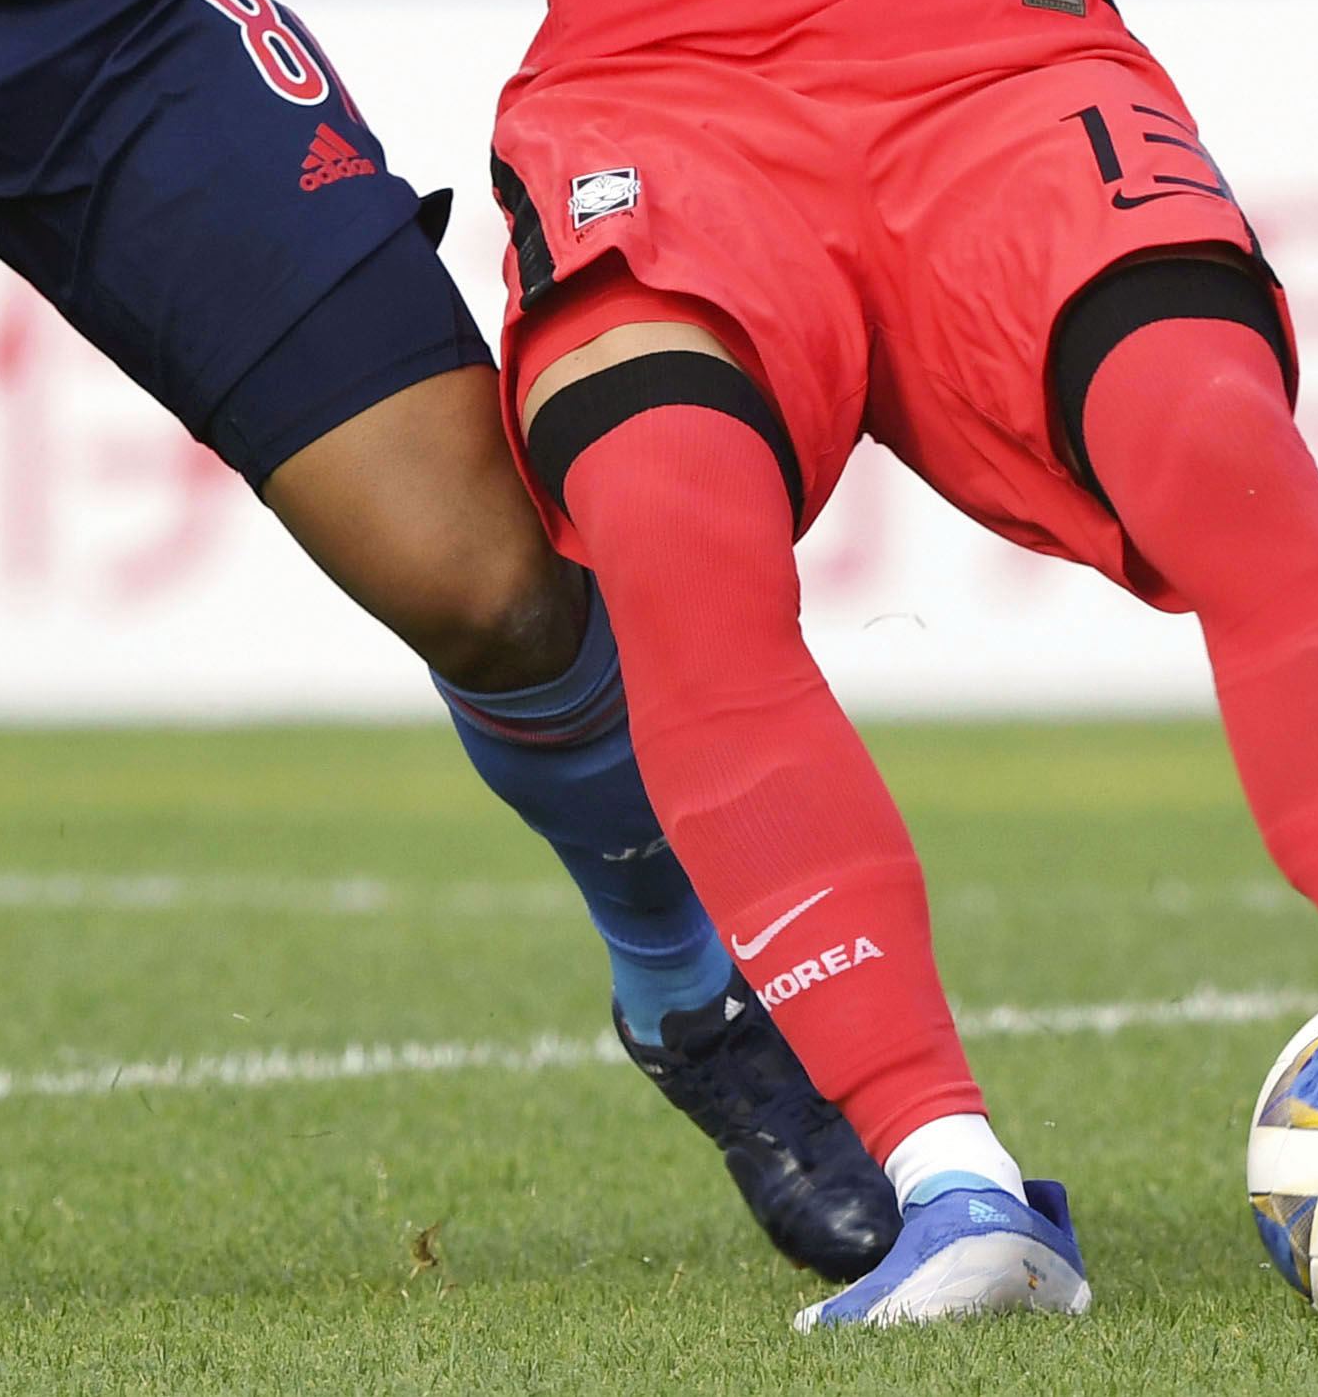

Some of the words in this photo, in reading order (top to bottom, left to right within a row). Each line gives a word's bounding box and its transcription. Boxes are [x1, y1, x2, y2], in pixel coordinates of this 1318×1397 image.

[299, 159, 376, 192] adidas
[1059, 103, 1233, 205] 13
[755, 936, 884, 1012] KOREA
